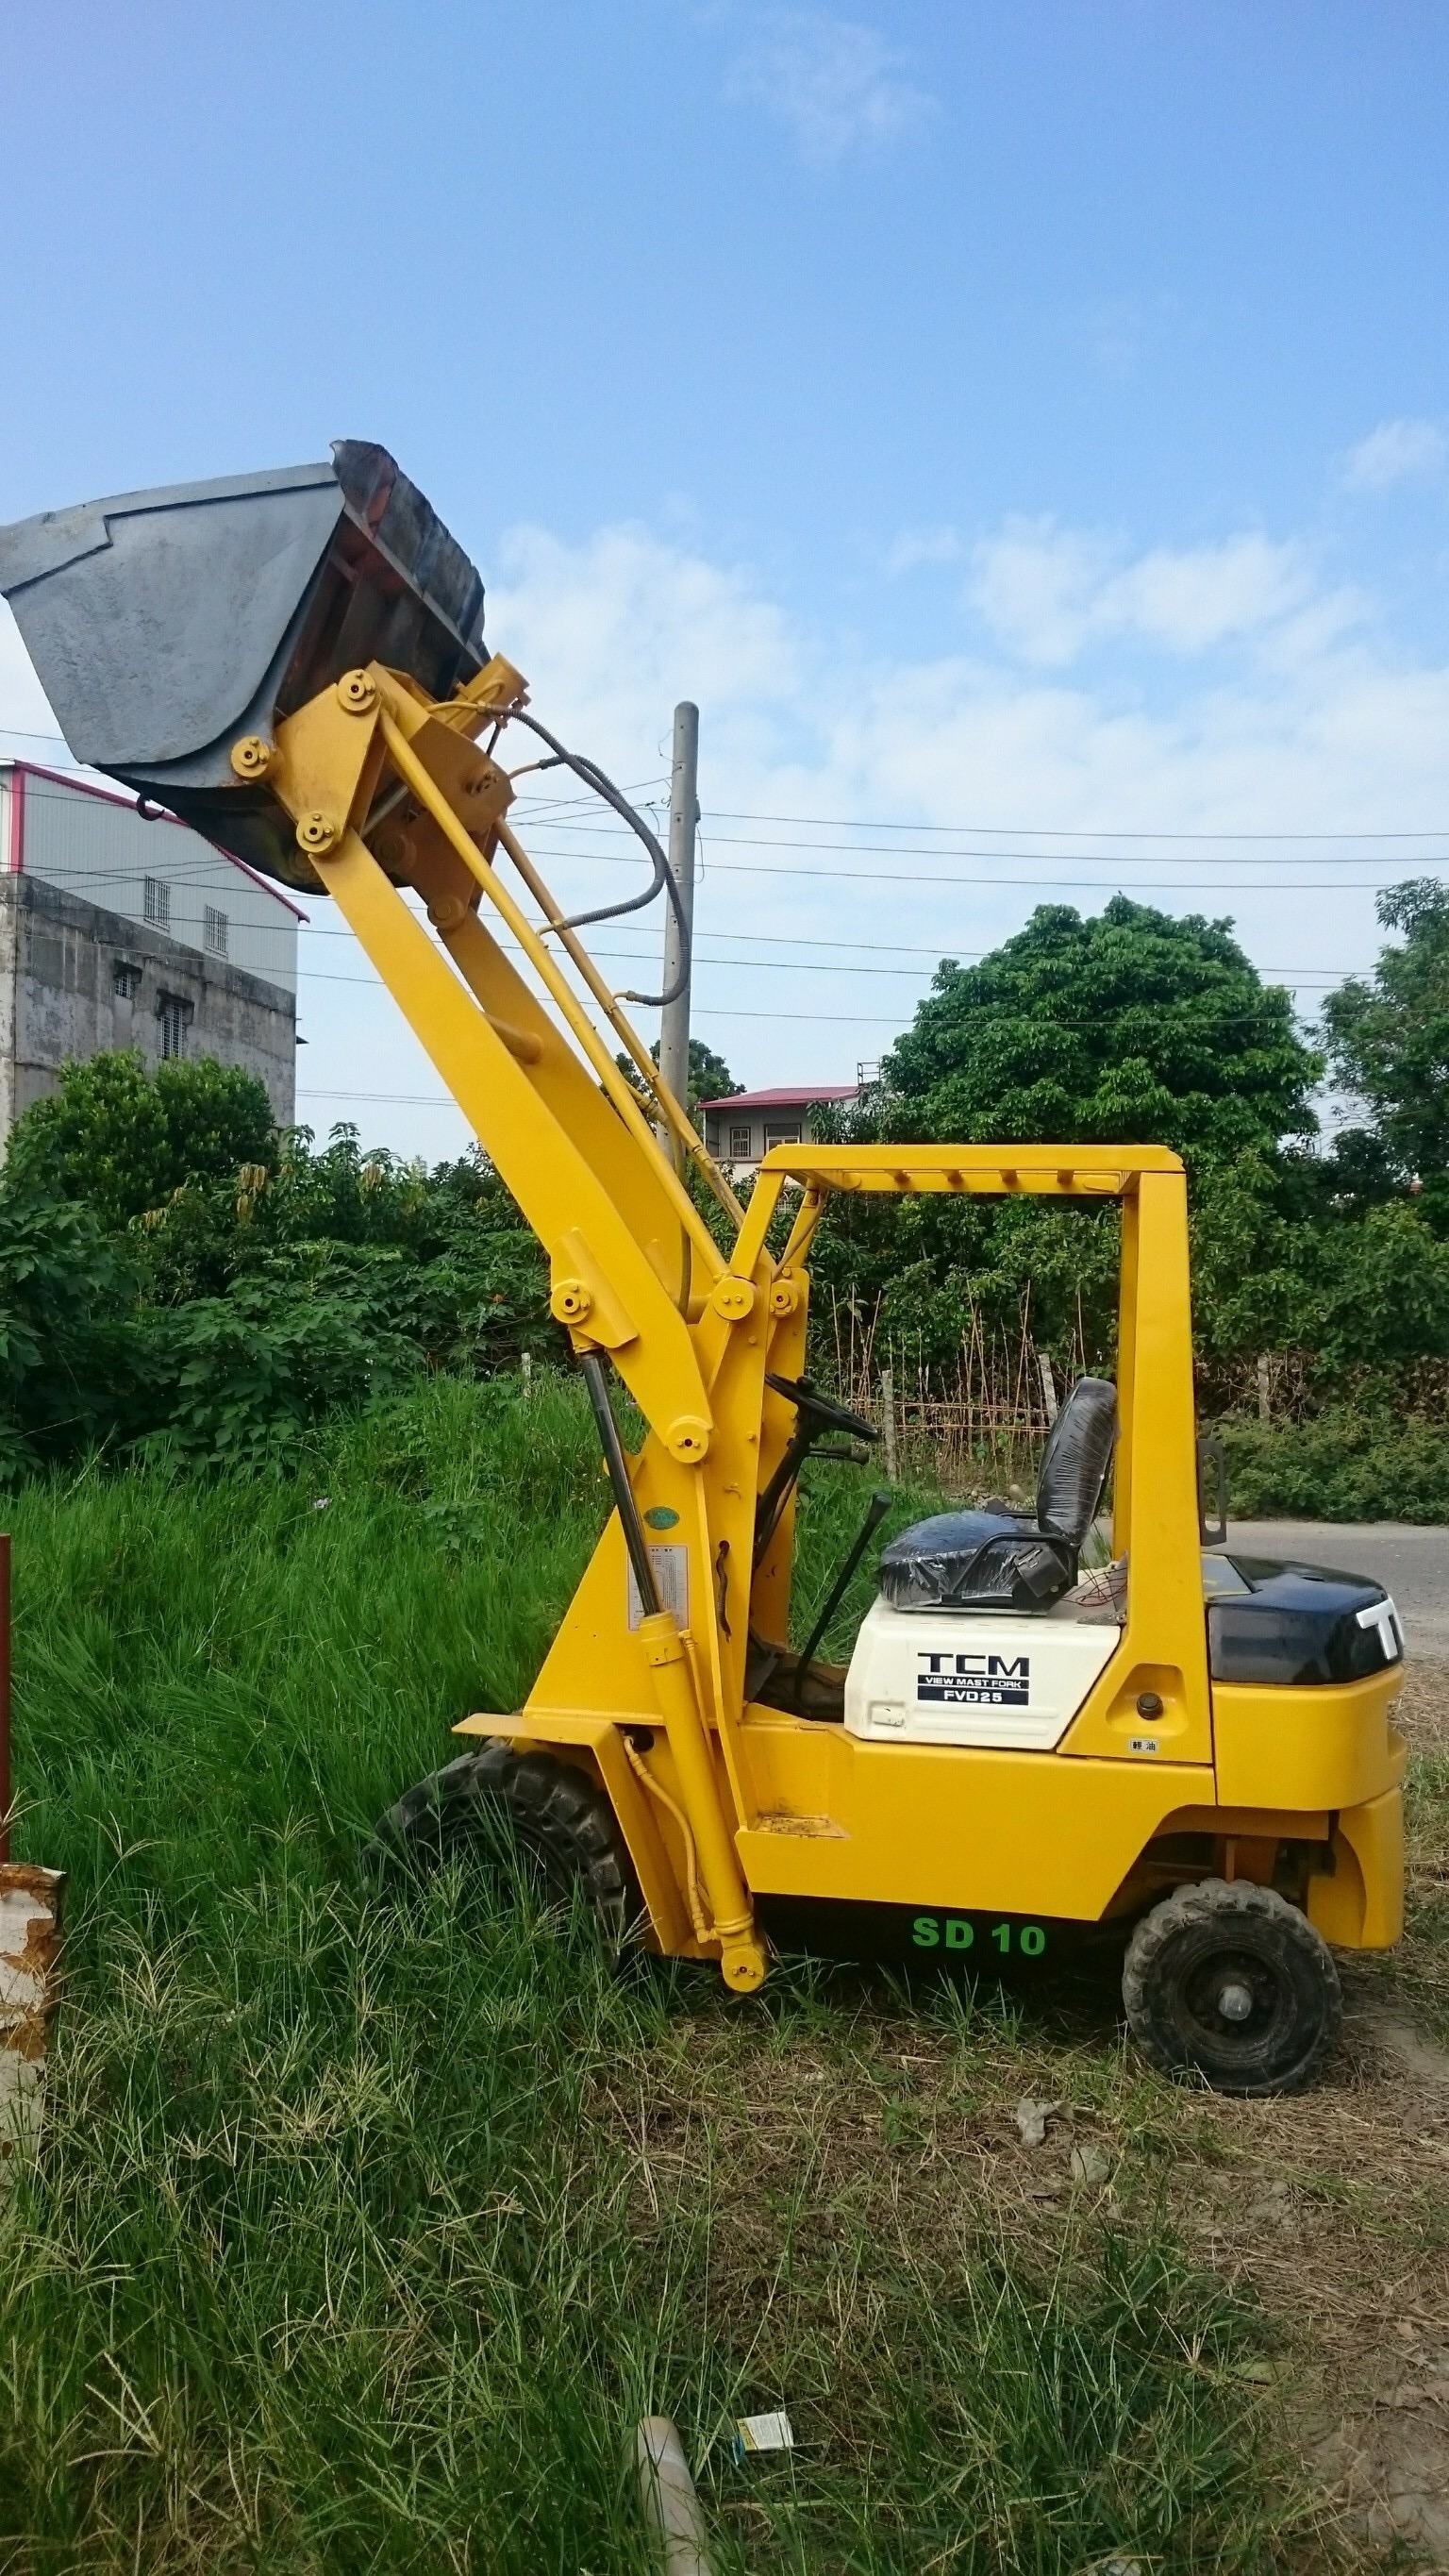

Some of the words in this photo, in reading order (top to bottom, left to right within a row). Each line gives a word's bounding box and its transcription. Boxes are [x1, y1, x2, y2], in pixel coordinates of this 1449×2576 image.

[918, 1652, 1029, 1677] TCM
[925, 1677, 954, 1685] VIEW
[956, 1679, 989, 1687] MAST
[991, 1680, 1022, 1688] FORK
[943, 1690, 1003, 1702] FVD25
[912, 1917, 974, 1949] SD
[991, 1923, 1046, 1955] 10
